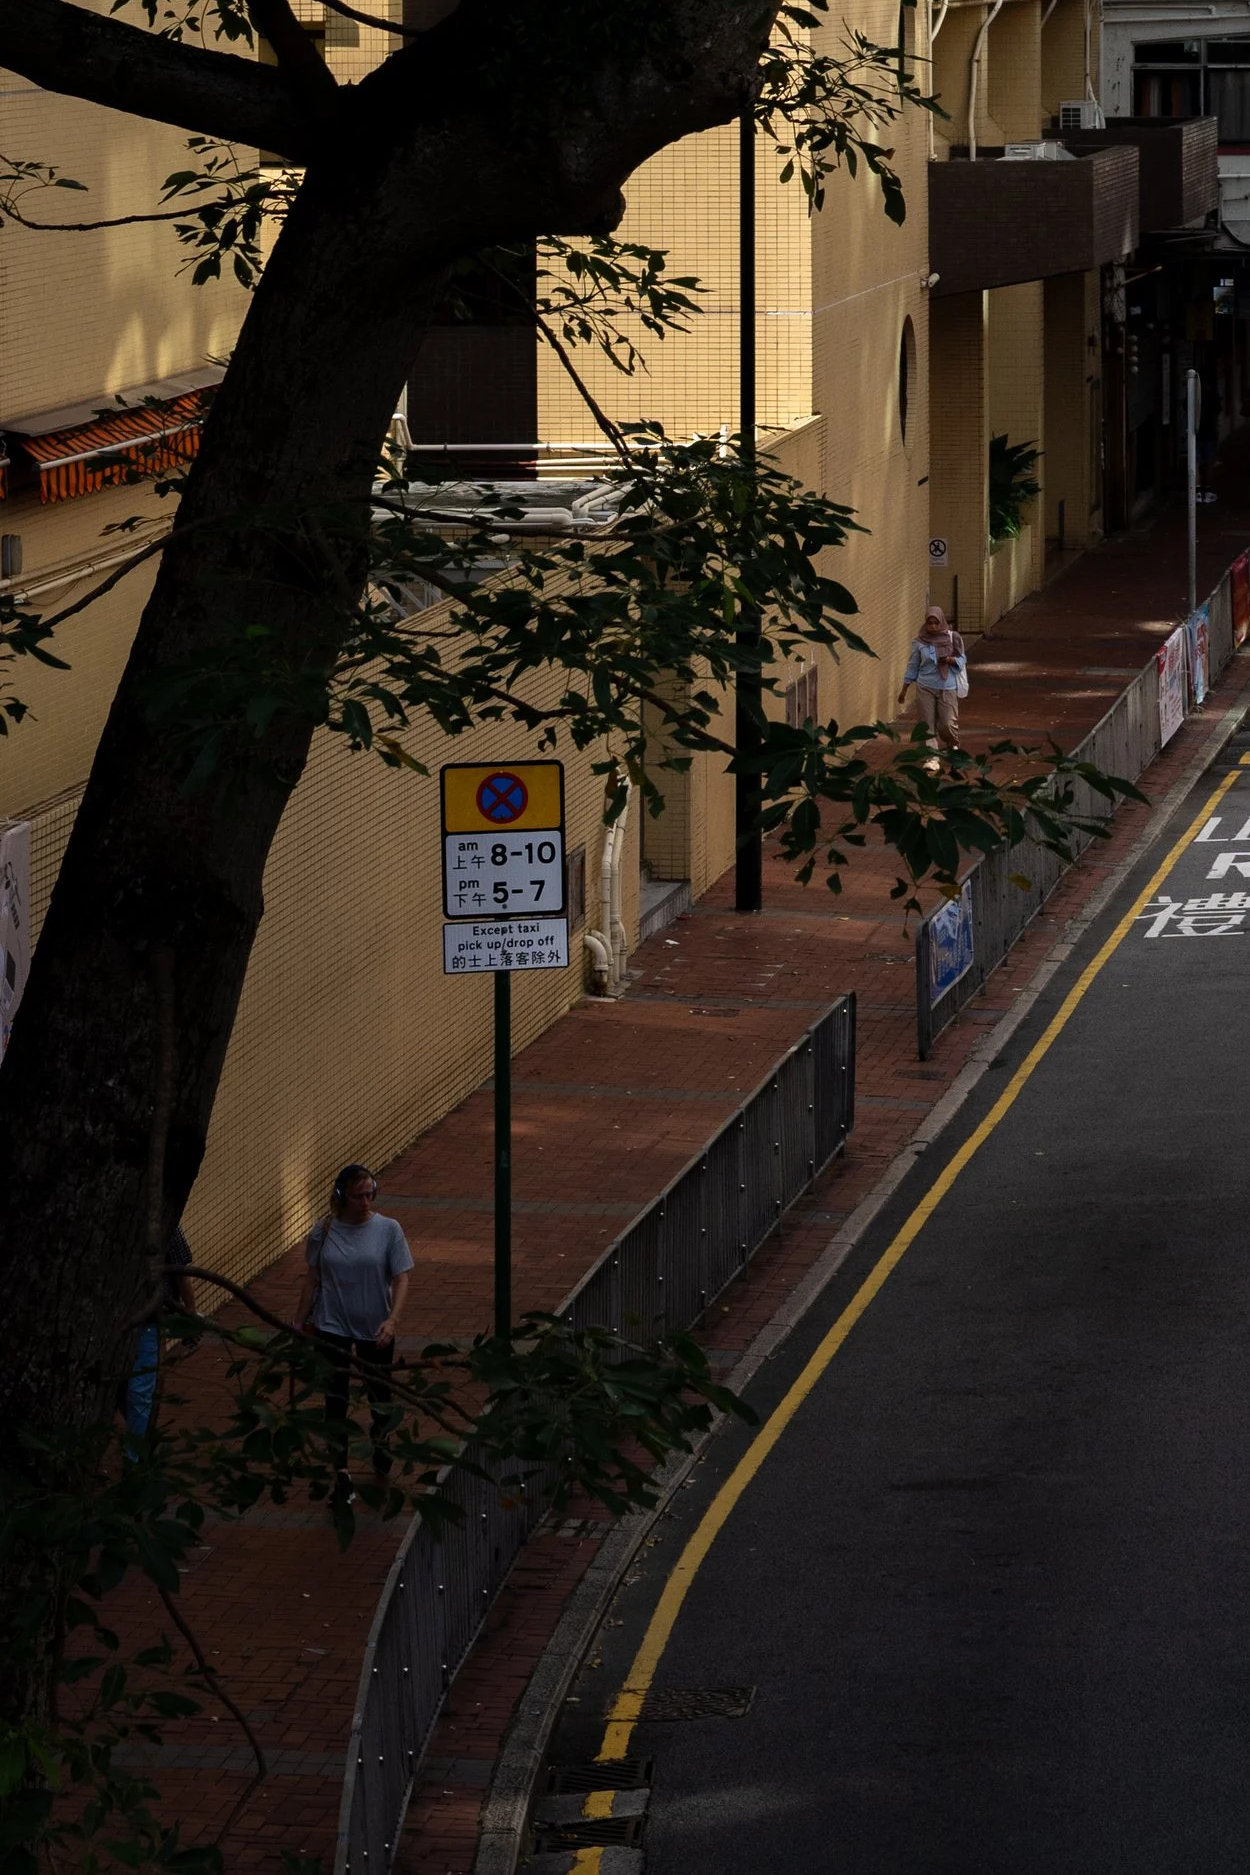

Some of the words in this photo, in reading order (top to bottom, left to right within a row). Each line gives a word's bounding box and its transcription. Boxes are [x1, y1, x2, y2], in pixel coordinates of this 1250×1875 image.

[458, 841, 479, 851] am
[491, 841, 556, 866] 8-10
[452, 854, 486, 870] 上午
[458, 879, 480, 891] pm
[492, 879, 546, 904] 5-7
[452, 892, 487, 908] 下午
[472, 924, 514, 937] Except
[517, 922, 540, 934] taxi
[458, 938, 482, 952] pick
[486, 937, 534, 952] up/drop
[537, 936, 555, 947] off
[451, 950, 561, 970] 的士上落客除外
